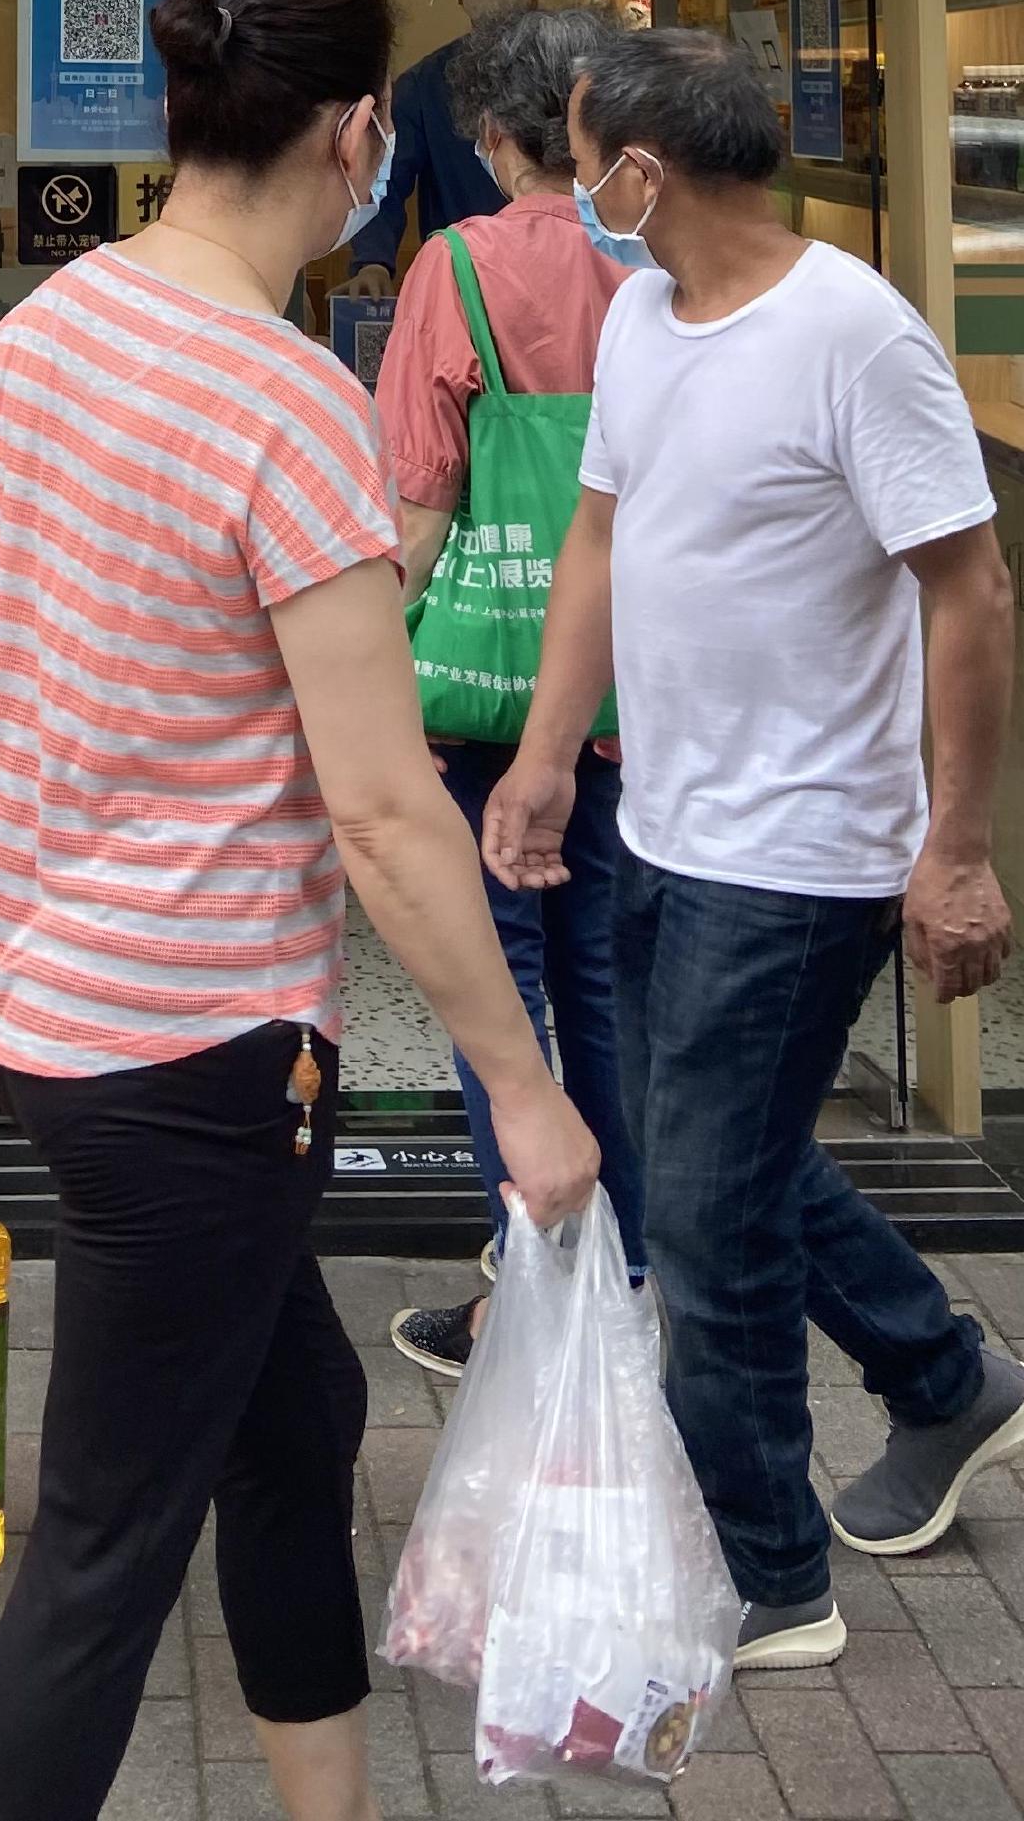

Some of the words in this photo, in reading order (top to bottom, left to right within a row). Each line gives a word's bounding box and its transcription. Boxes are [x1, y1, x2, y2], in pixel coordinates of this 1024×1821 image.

[33, 234, 101, 248] 禁止带入宠物
[50, 249, 66, 257] NO
[391, 1150, 475, 1163] 小心台
